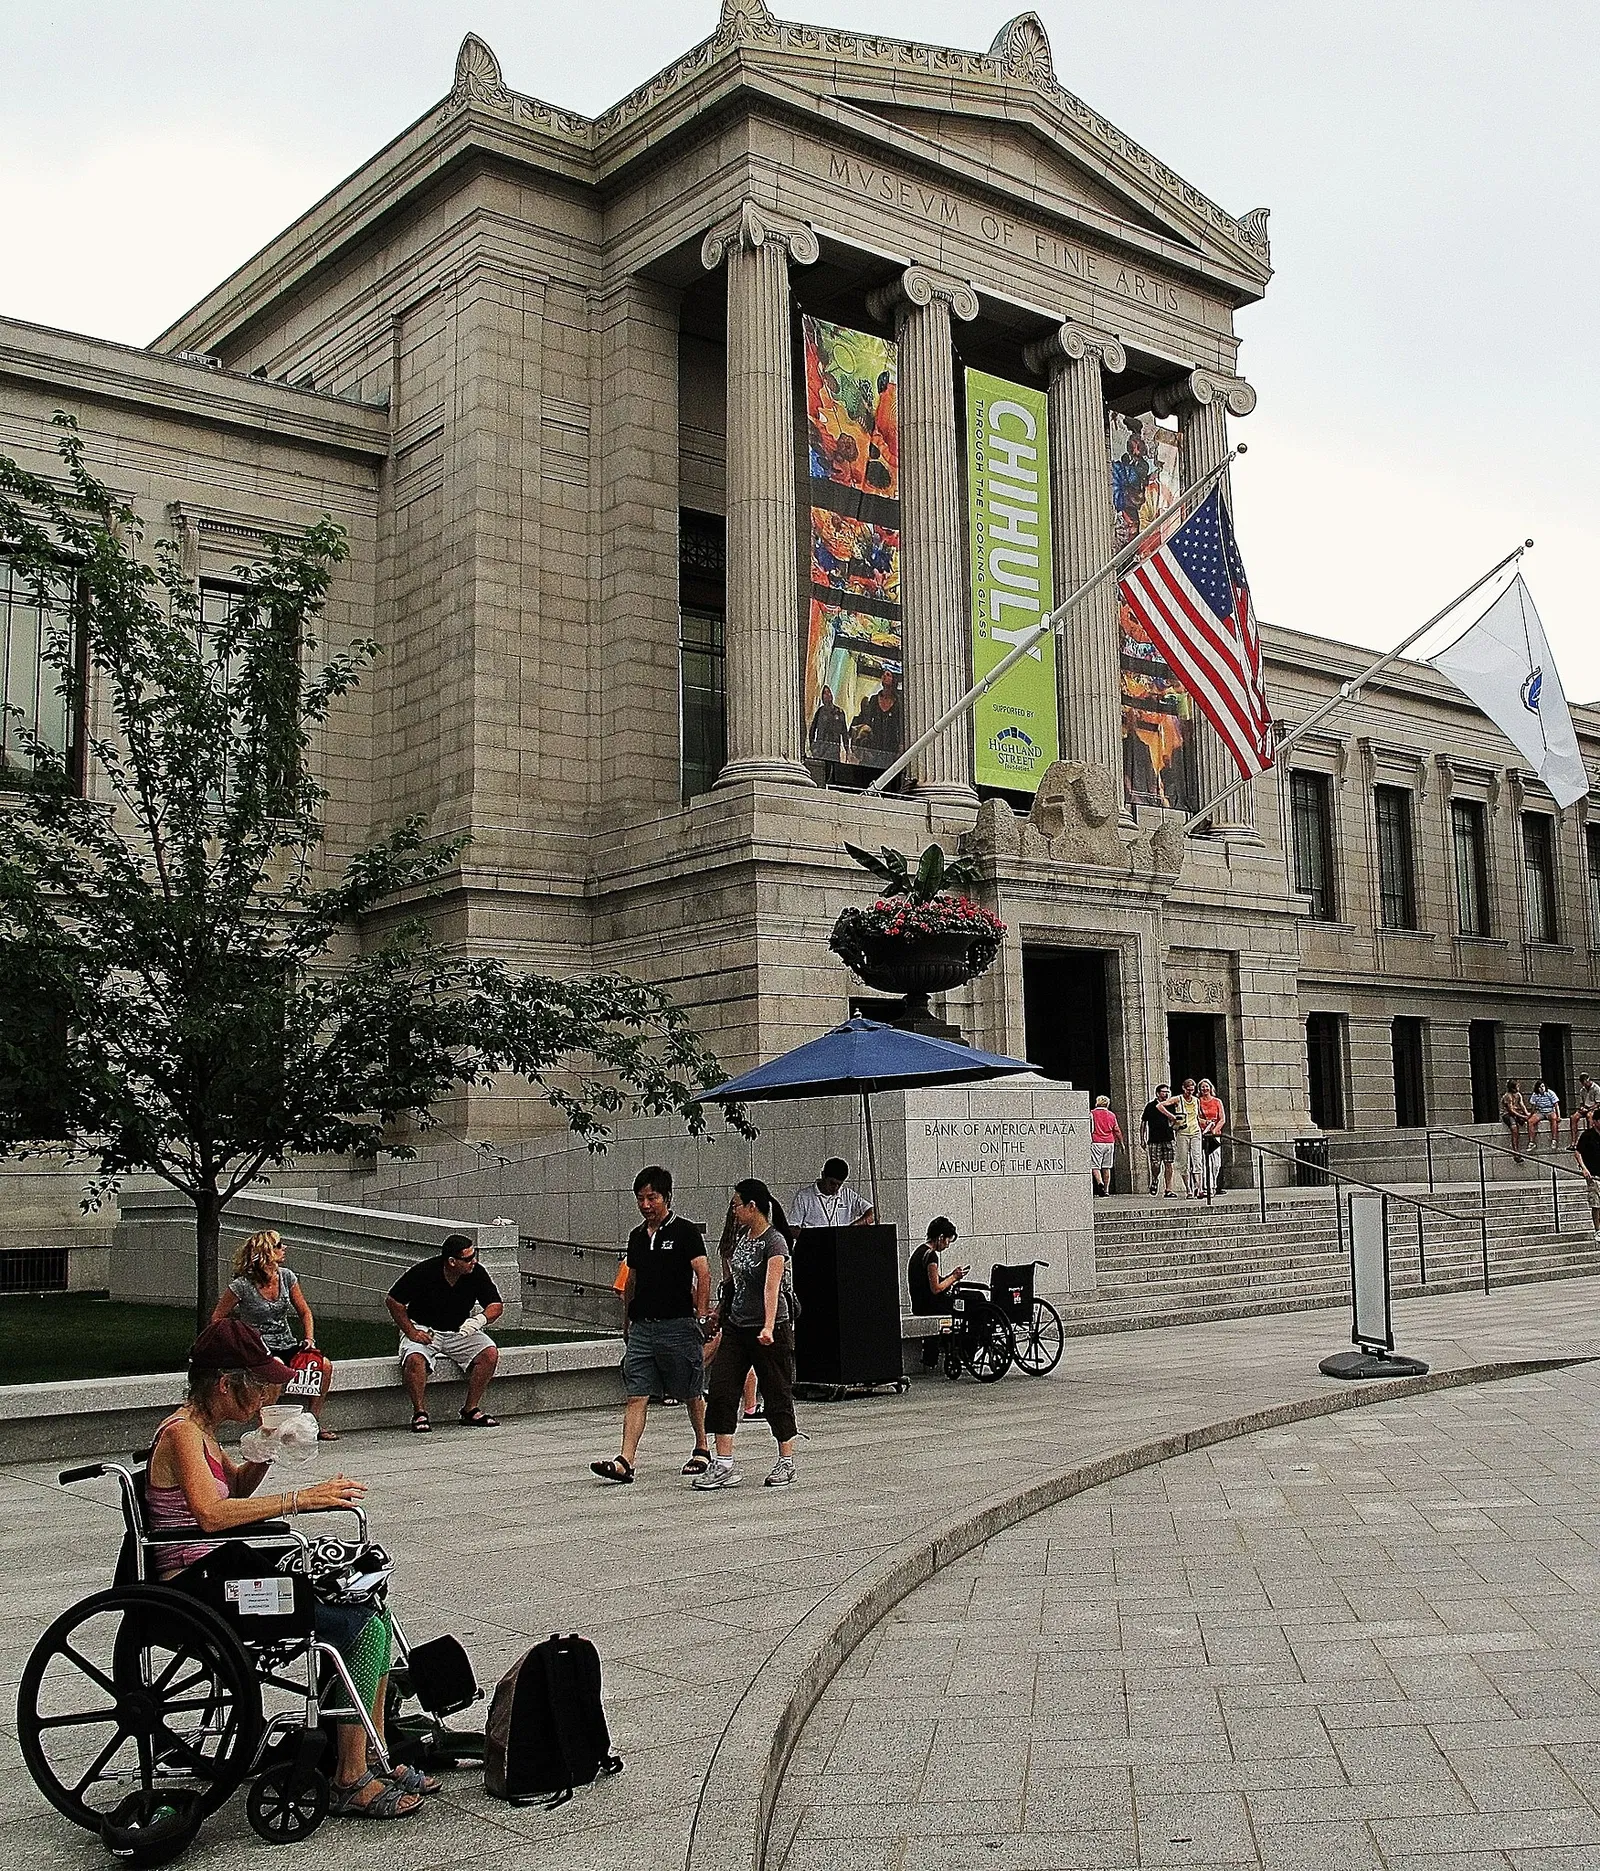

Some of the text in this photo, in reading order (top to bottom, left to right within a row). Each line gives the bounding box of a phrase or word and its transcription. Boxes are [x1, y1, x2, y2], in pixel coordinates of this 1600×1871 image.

[829, 153, 1179, 311] MVSEVM OF FINE ARTS
[975, 399, 987, 638] THROUGH THE LOOKING GLASS
[988, 400, 1042, 662] CHIHULY
[992, 703, 1035, 718] SUPPORTED BY
[998, 752, 1034, 769] STREET
[925, 1123, 1076, 1136] BANK OF AMERICA PLAZA
[980, 1141, 1025, 1154] ON THE
[939, 1158, 1064, 1173] AVENUE OF THE ARTS
[287, 1385, 321, 1395] OSTON
